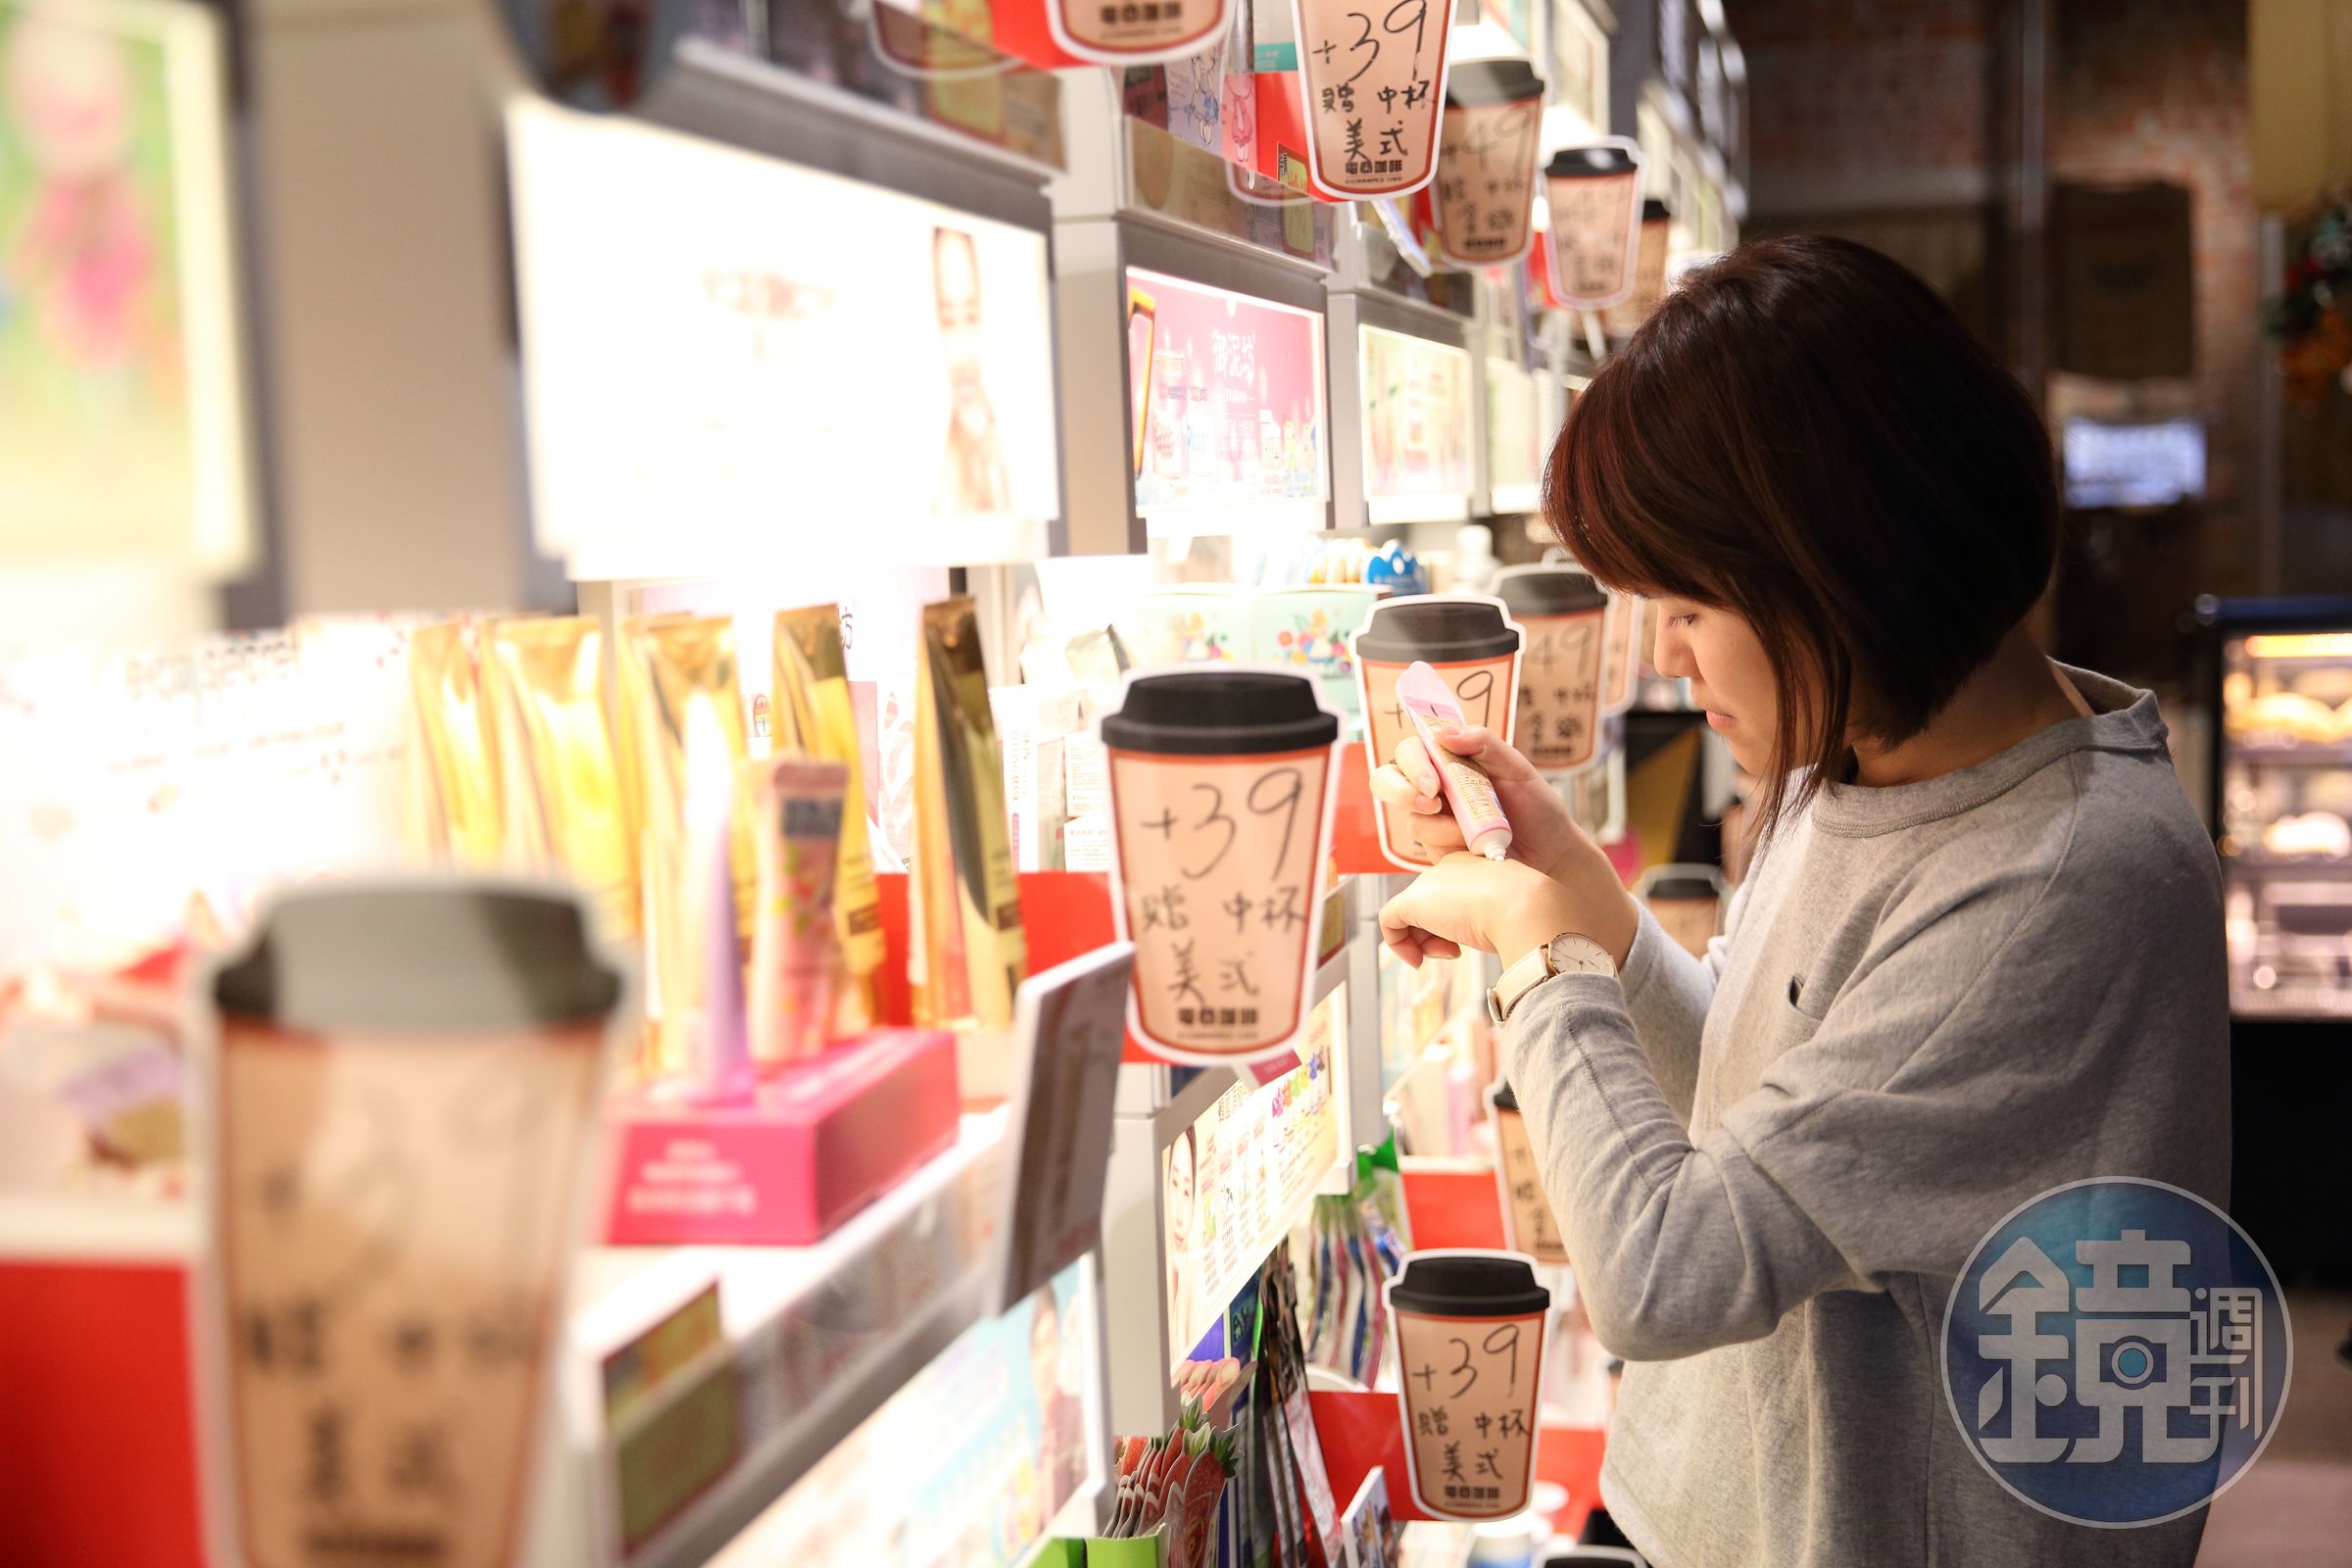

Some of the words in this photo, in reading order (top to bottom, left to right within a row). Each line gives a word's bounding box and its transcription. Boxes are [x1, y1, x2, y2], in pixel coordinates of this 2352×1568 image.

[1312, 0, 1427, 82] +39
[1344, 118, 1408, 162] 美式
[1141, 767, 1303, 880] +39
[1412, 1324, 1519, 1399] +39
[1443, 1441, 1503, 1484] 美式
